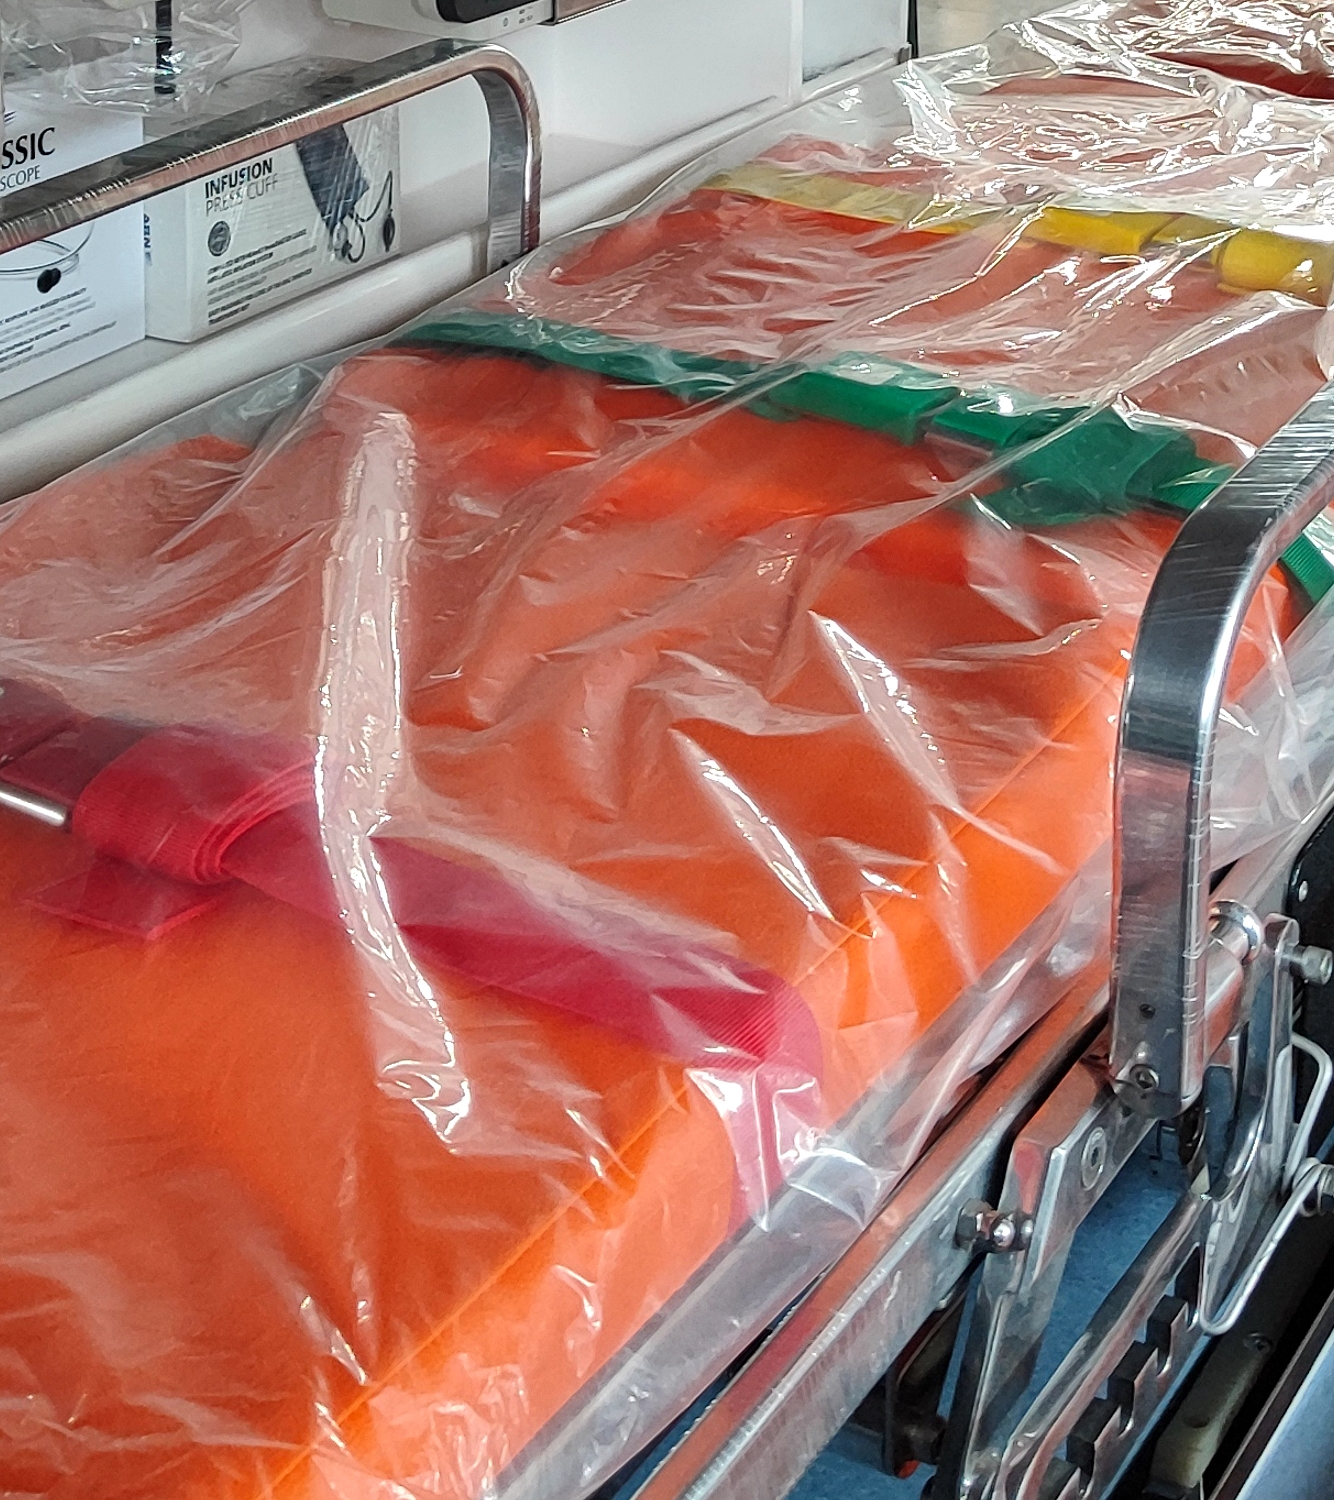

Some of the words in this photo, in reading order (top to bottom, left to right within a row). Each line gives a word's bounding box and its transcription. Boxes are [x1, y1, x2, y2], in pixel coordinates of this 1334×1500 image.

[1, 126, 56, 170] SSIC
[204, 157, 274, 199] INFUSION
[246, 172, 279, 200] CUFF
